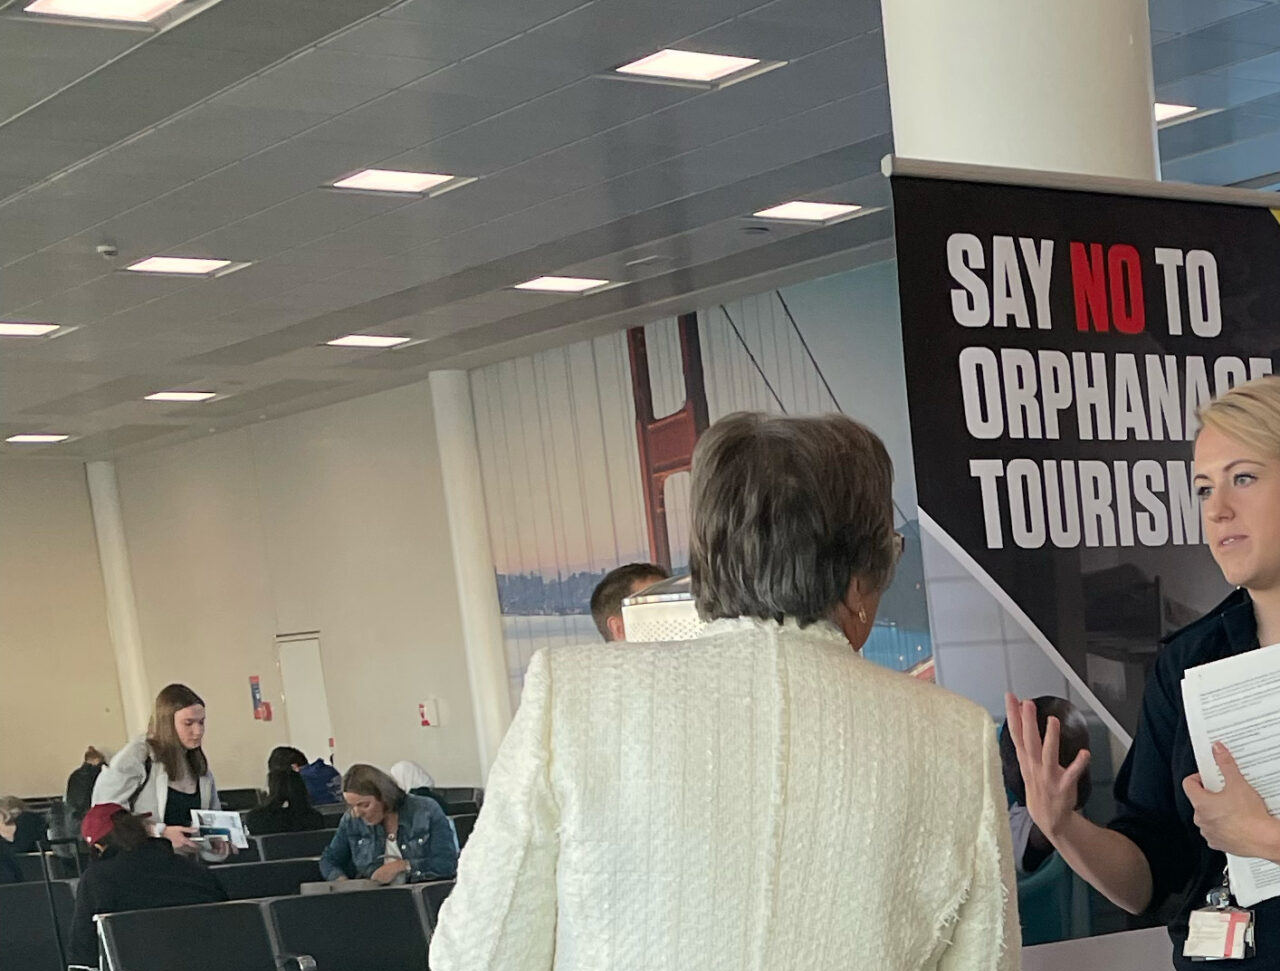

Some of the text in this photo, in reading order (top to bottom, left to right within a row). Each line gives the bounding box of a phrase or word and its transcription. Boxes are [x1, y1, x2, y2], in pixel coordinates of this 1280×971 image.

[946, 232, 1223, 339] SAY NO TO
[959, 346, 1274, 441] ORPHANA
